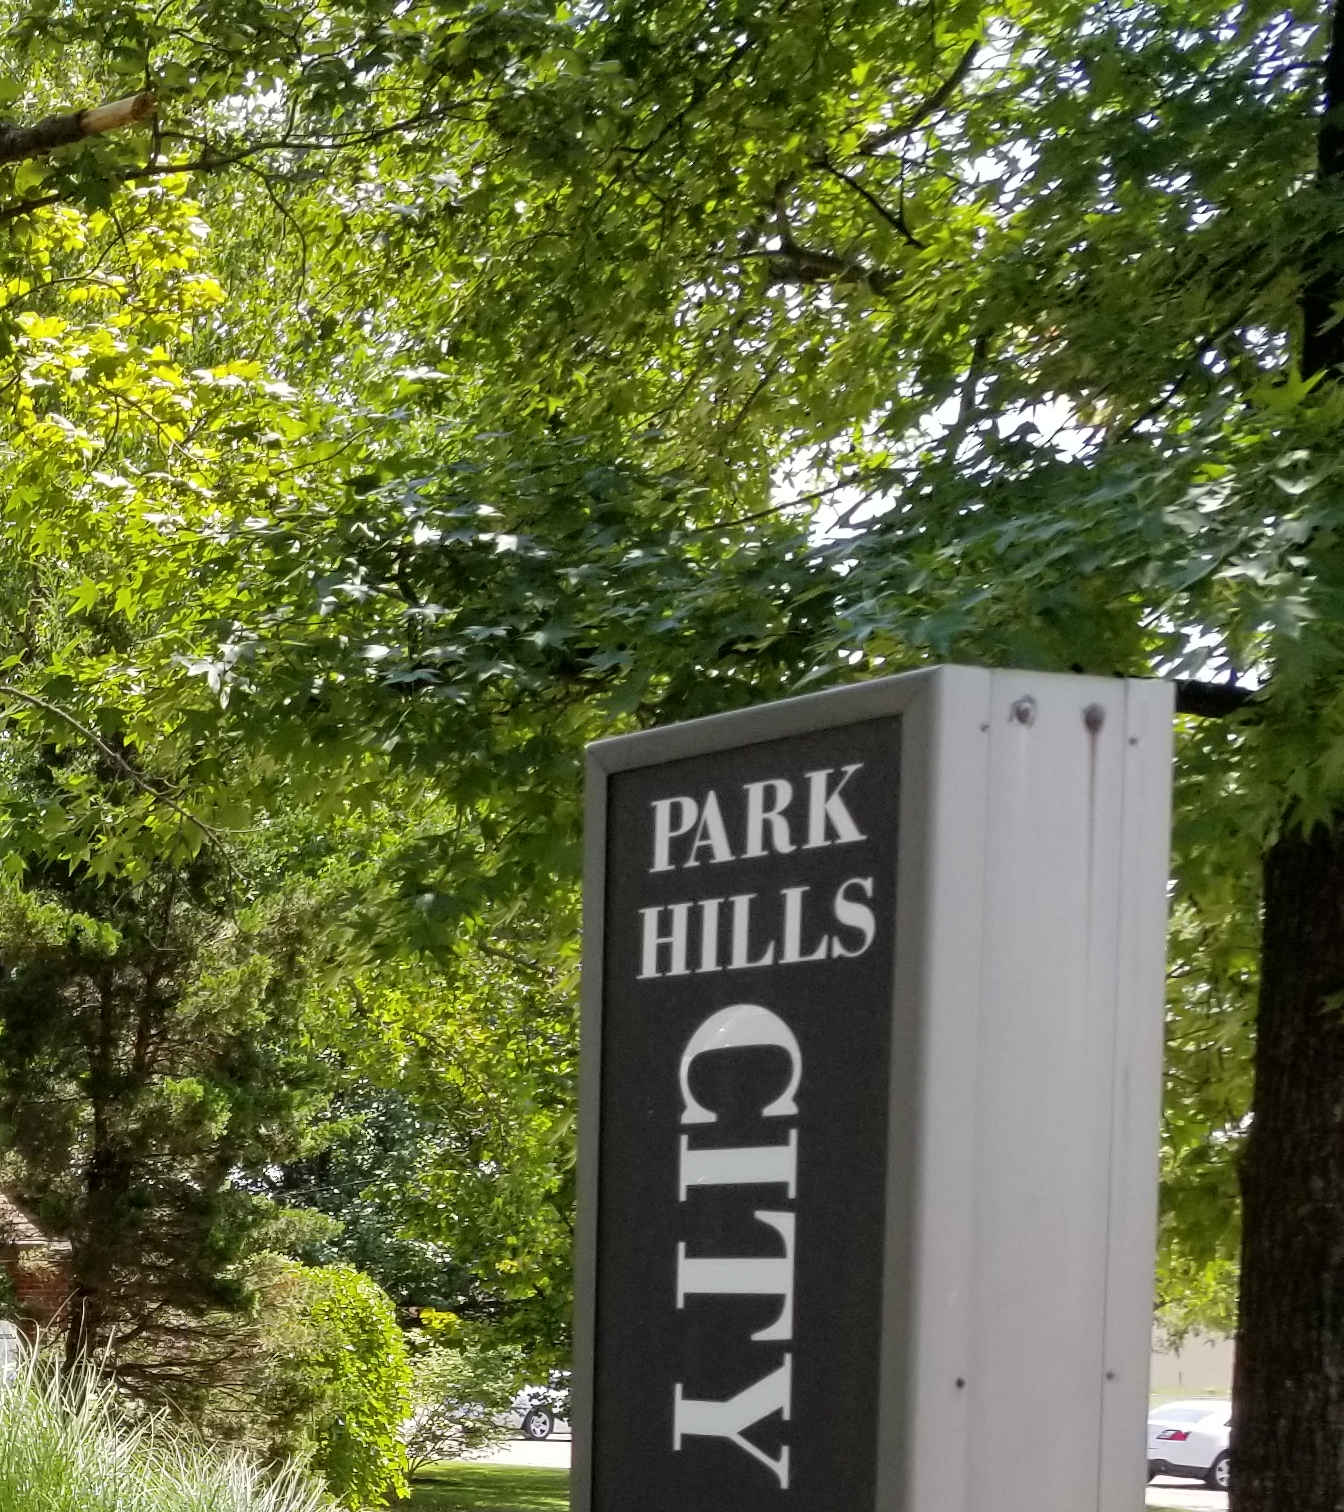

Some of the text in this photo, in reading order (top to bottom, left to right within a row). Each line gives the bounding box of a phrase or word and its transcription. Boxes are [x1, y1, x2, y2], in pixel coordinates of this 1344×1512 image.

[648, 762, 869, 874] PARK
[635, 876, 878, 981] HILLS
[672, 1002, 803, 1490] CITY
